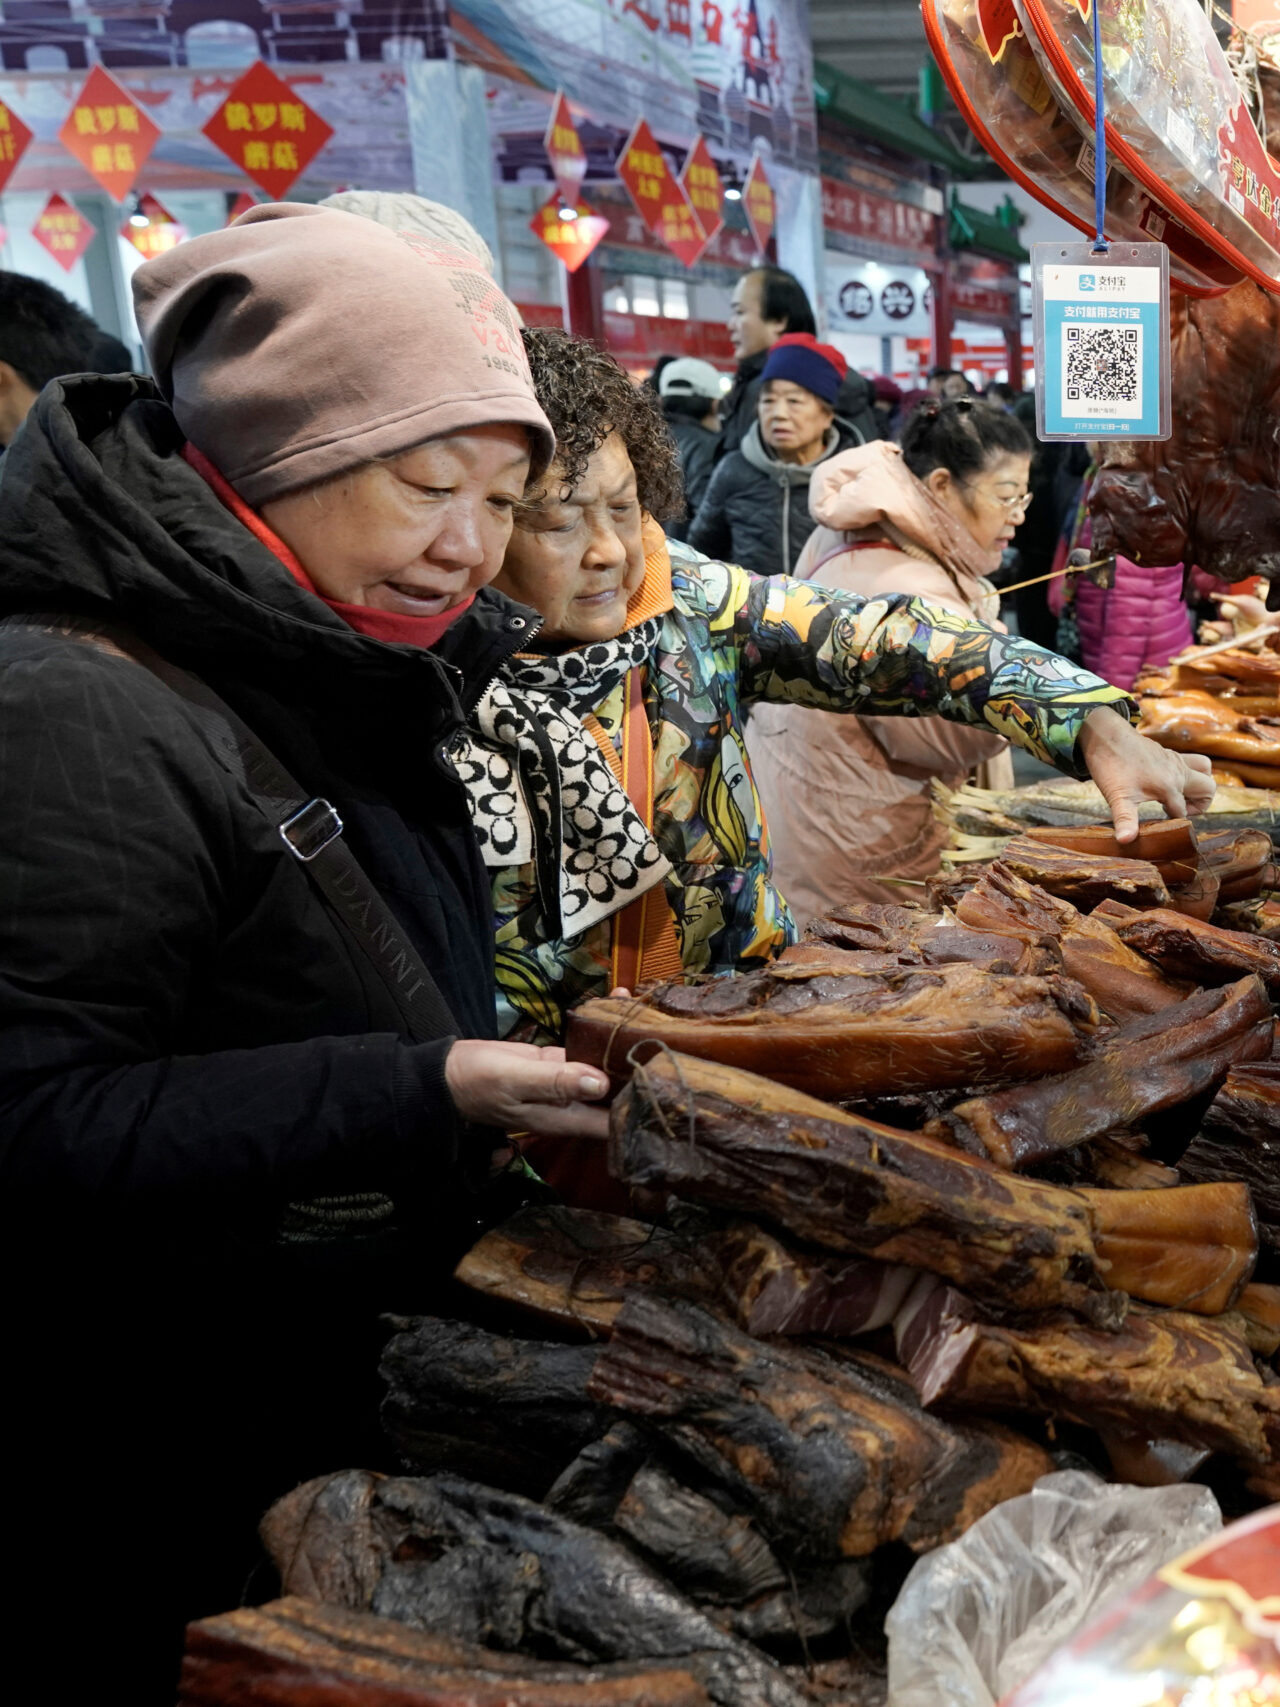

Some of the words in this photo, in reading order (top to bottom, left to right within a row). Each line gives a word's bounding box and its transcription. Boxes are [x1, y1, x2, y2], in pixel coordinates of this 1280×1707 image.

[1099, 275, 1126, 287] 支付宝
[1064, 306, 1141, 319] 支付就用支付宝
